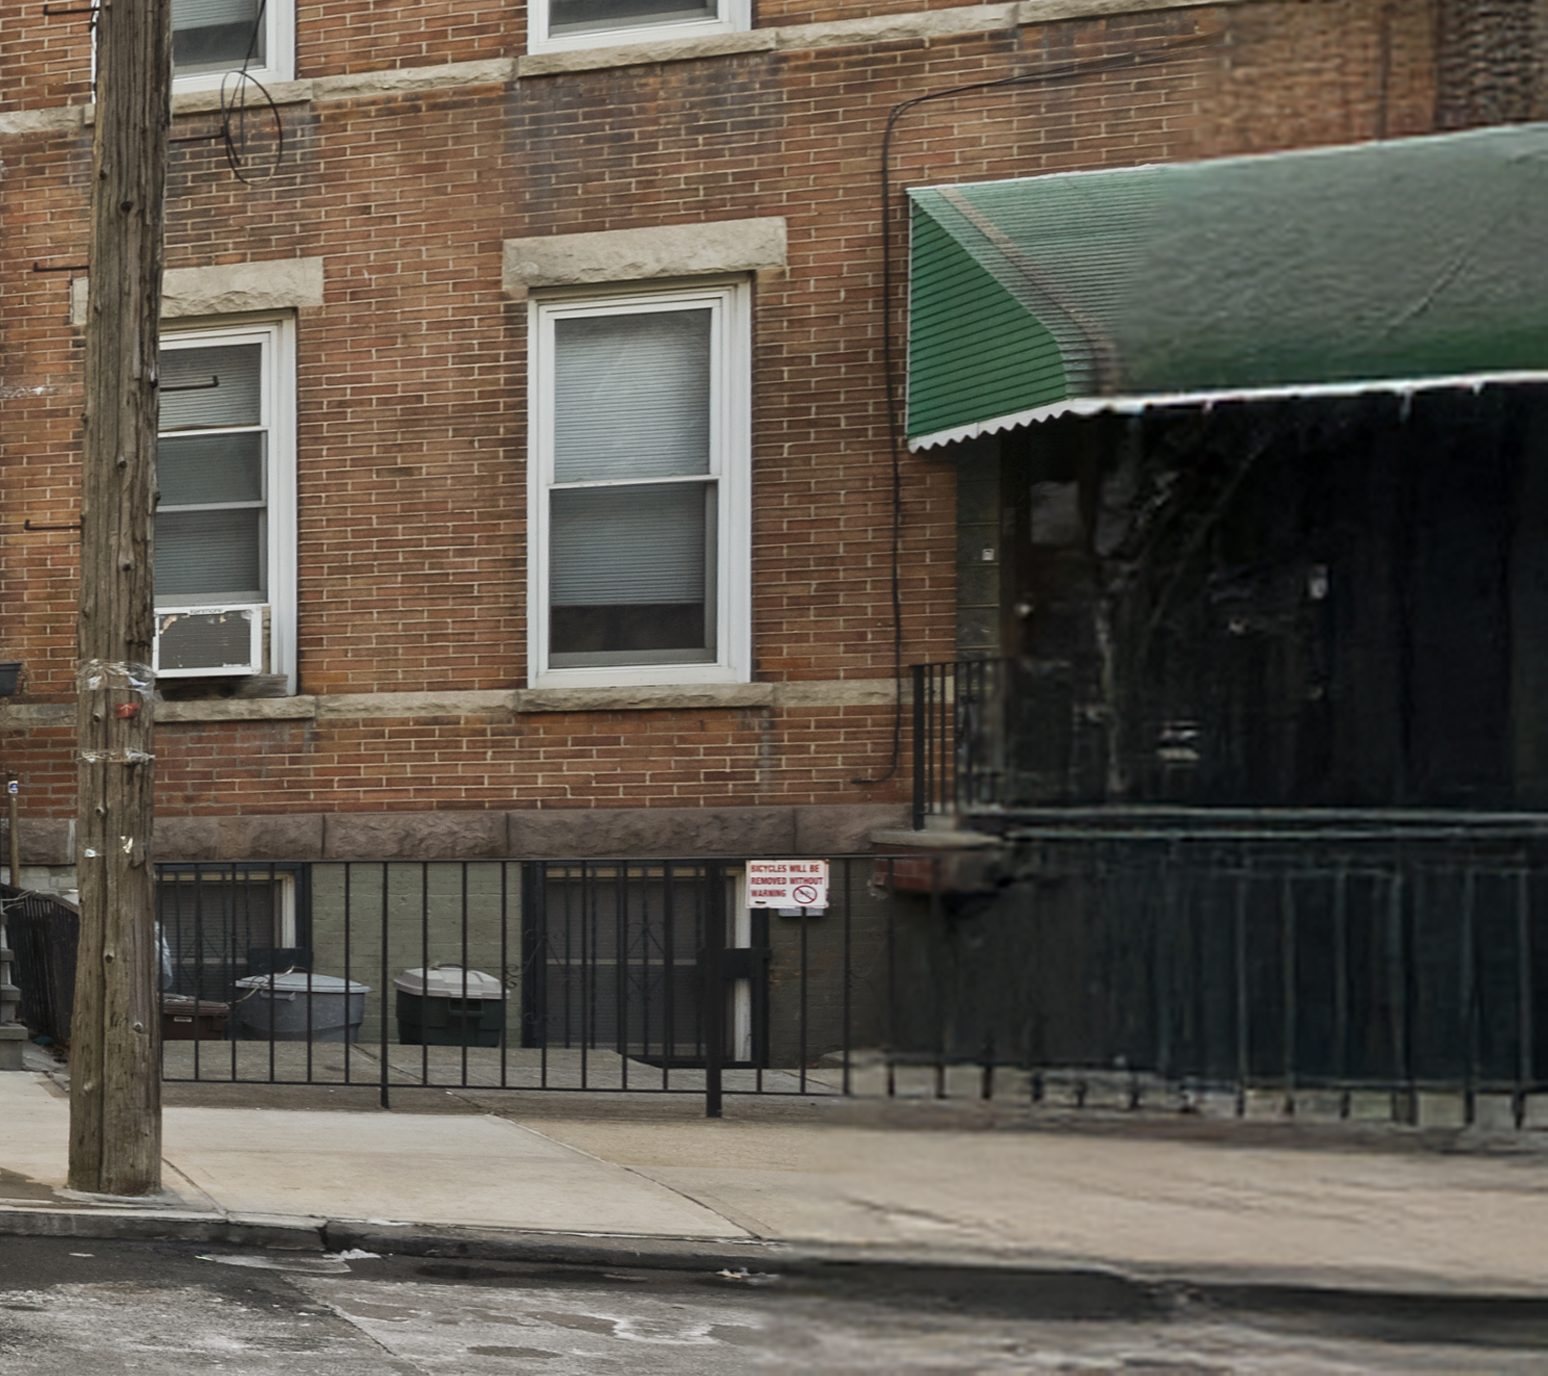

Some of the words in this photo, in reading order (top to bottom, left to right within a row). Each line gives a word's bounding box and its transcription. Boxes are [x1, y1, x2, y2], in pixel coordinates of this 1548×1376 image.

[751, 864, 787, 872] BICYCLES
[789, 864, 806, 872] WILL
[809, 864, 820, 872] BE
[751, 877, 786, 885] REMOVED
[789, 877, 823, 885] WITHOUT
